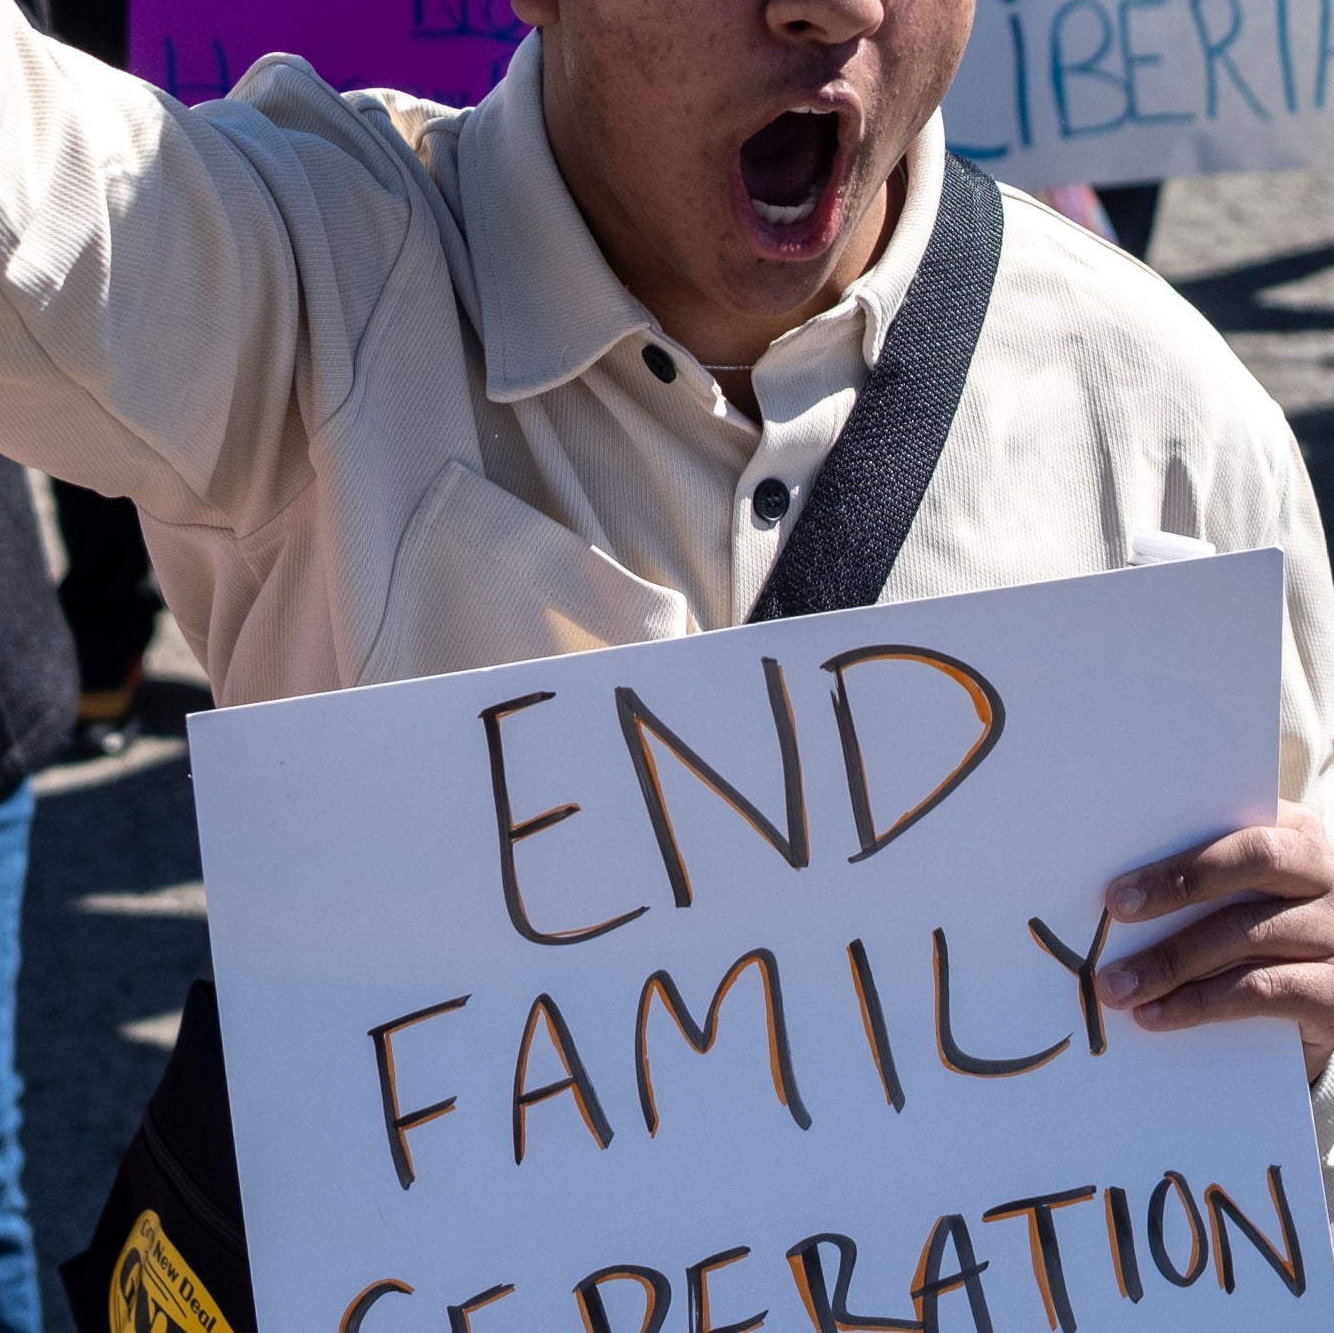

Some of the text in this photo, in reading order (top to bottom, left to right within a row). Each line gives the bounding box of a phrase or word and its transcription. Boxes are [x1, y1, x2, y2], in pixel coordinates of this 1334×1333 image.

[479, 644, 1005, 945] END
[368, 904, 1112, 1190] FAMILY
[152, 1240, 179, 1283] New
[178, 1276, 217, 1333] Deal
